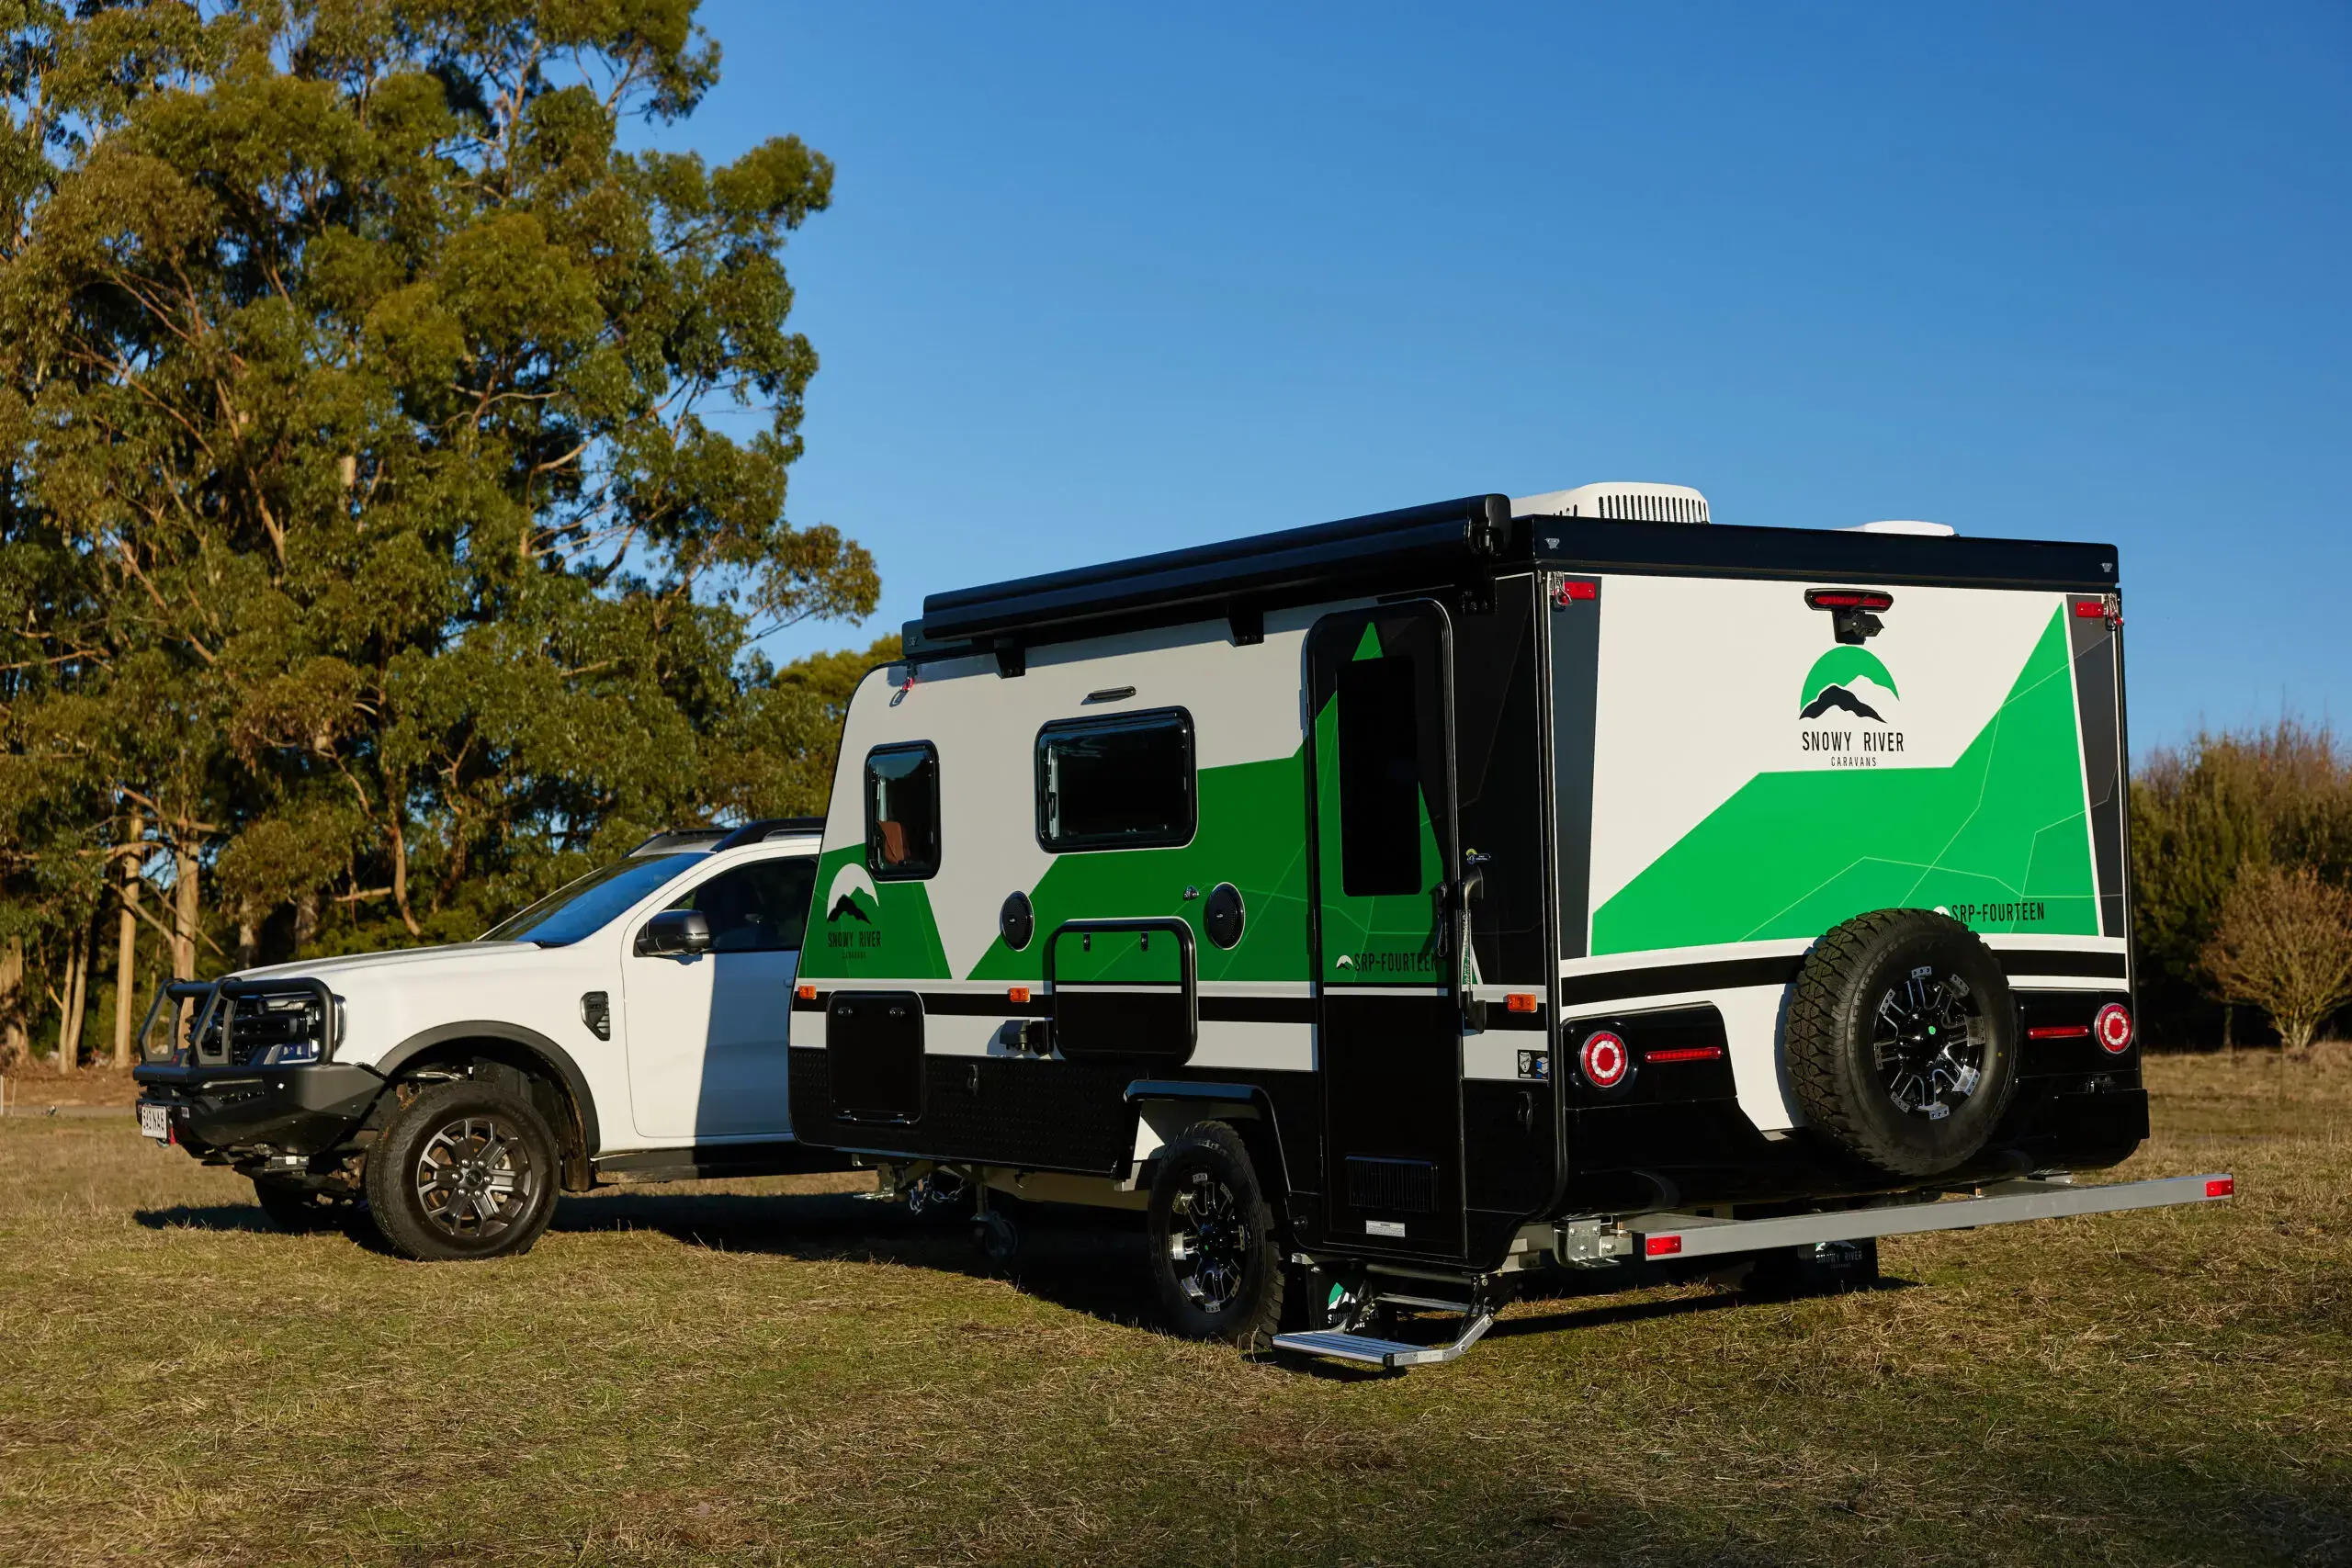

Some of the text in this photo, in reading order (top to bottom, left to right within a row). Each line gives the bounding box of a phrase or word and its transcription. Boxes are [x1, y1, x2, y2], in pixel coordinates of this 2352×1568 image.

[1802, 731, 1904, 751] SNOWY RIVER
[1831, 757, 1877, 767] CARAVANS
[1951, 902, 2045, 922] SRP-FOURTEEN
[828, 931, 881, 947] SNOWY RIVER
[1815, 1250, 1863, 1264] SNOWY RIVER
